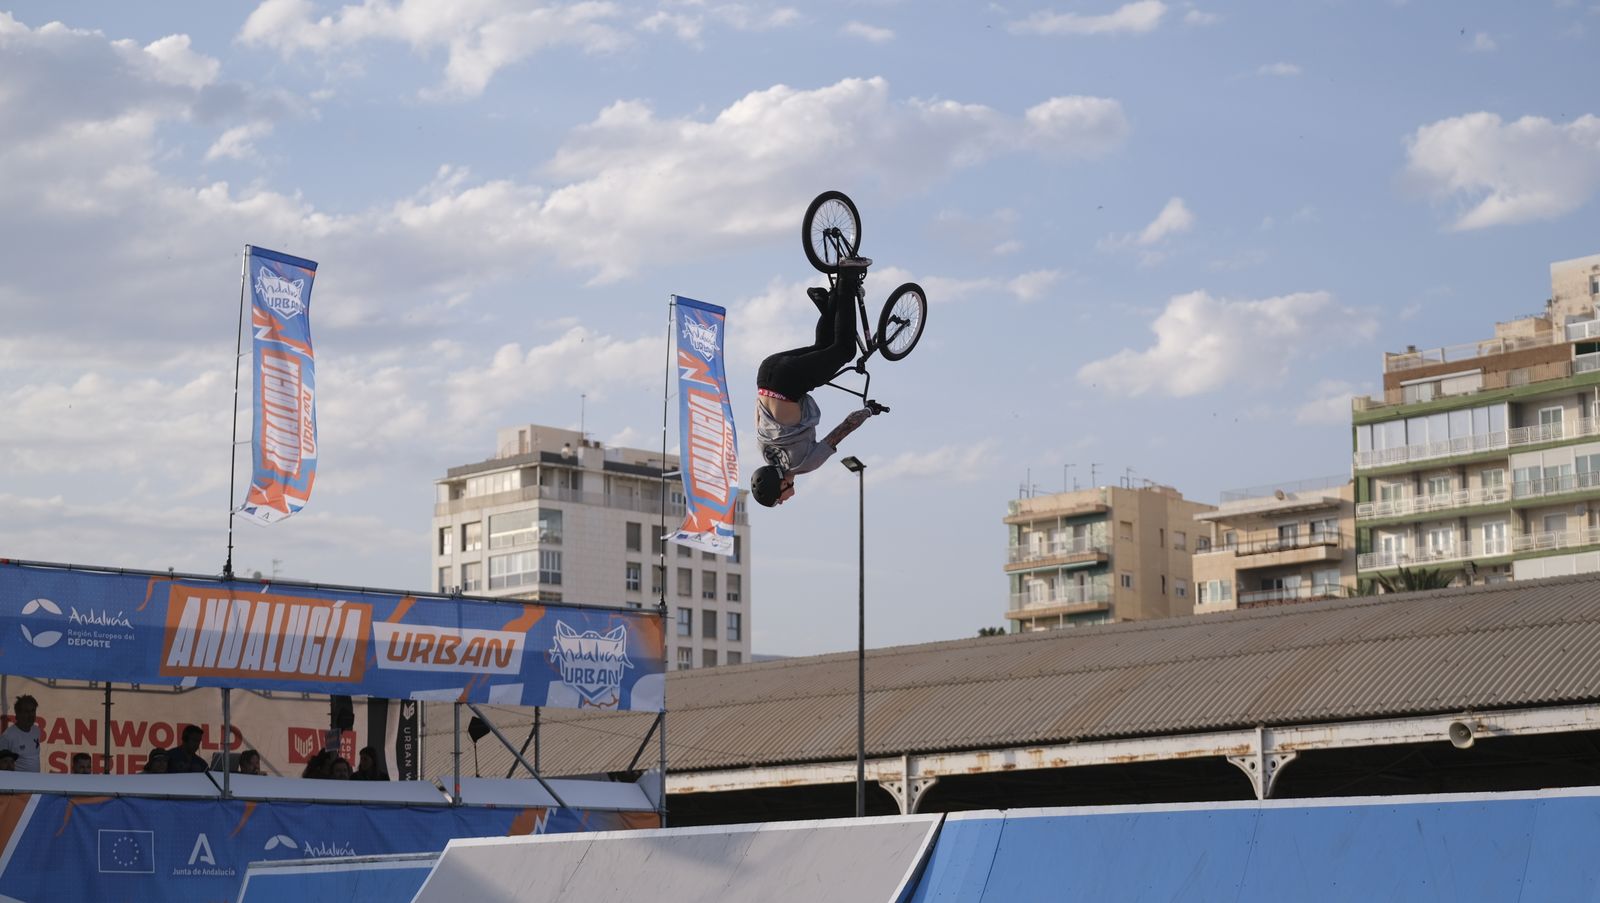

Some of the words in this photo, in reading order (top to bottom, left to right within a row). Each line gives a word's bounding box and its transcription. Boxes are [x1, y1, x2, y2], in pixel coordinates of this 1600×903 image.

[68, 606, 134, 630] Andalucía
[68, 629, 92, 639] Región
[124, 632, 135, 641] del
[68, 638, 111, 648] DEPORTE
[166, 596, 362, 678] ANDALUCÍA
[386, 631, 516, 668] URBAN
[551, 640, 634, 668] Andalucía
[564, 667, 619, 686] URBAN
[403, 727, 412, 767] URBAN
[303, 840, 356, 857] Andalucía
[172, 867, 192, 875] Junta
[193, 868, 201, 876] de
[202, 867, 236, 876] Andalucía
